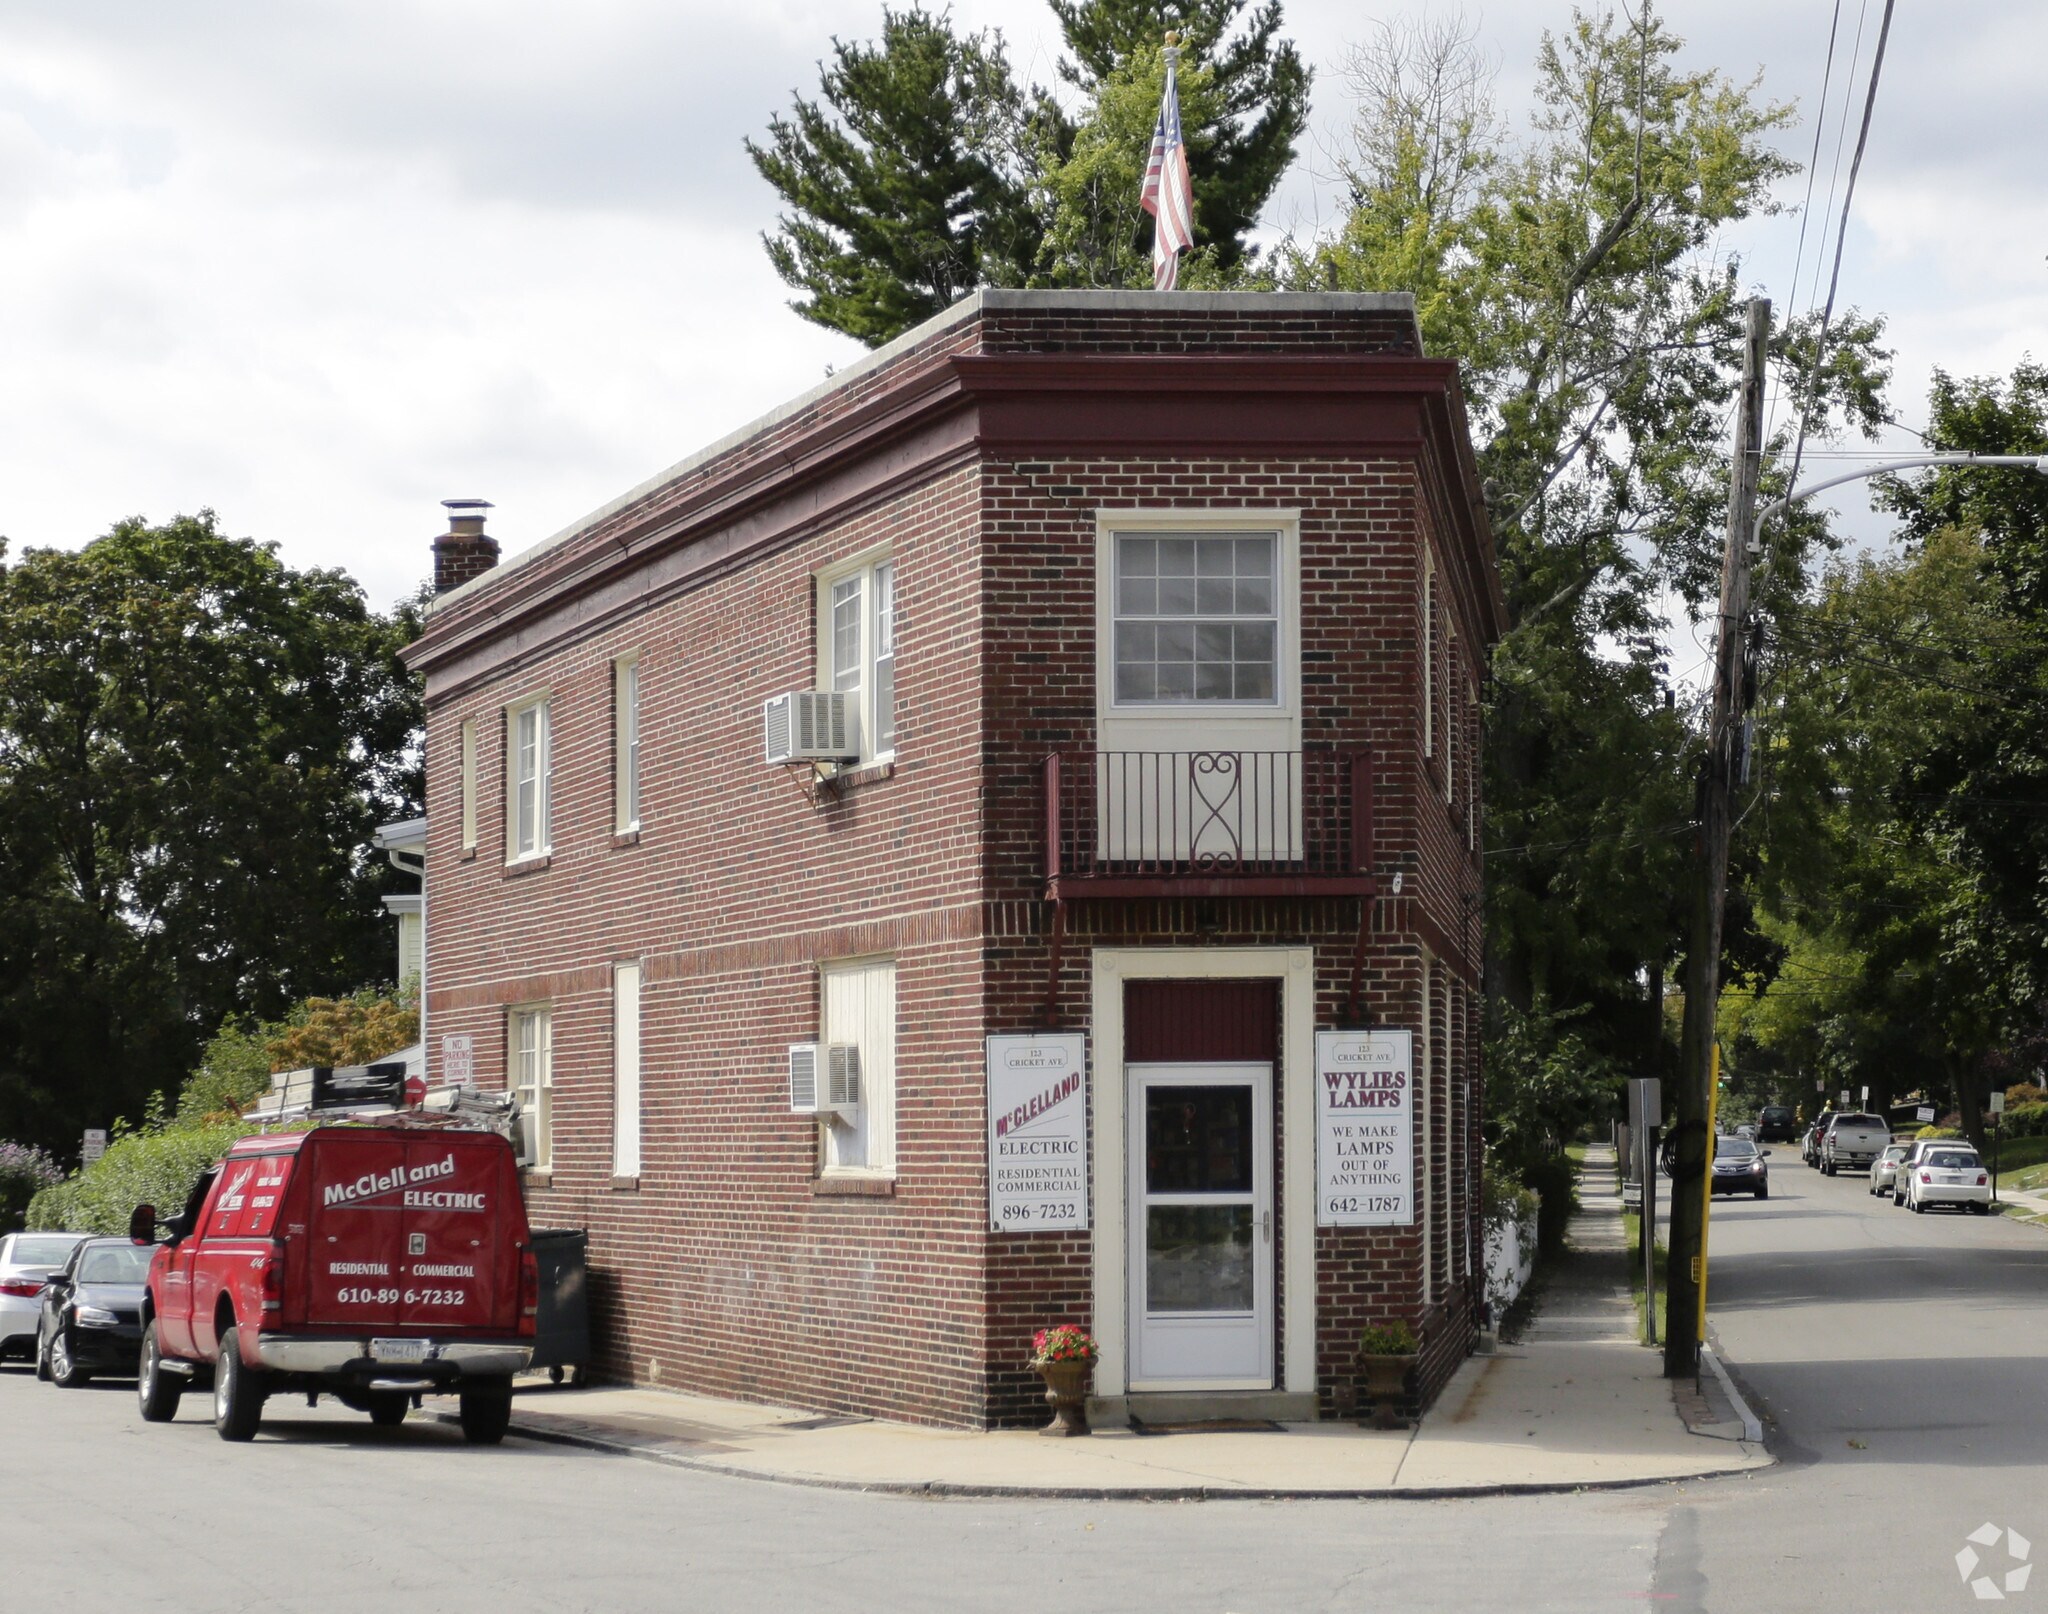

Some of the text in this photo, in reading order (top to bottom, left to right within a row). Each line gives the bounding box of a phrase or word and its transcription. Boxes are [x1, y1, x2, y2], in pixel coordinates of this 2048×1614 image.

[452, 1040, 462, 1049] NO
[1358, 1045, 1370, 1053] 123
[445, 1050, 470, 1060] PARKING
[1030, 1049, 1042, 1057] 123
[1337, 1053, 1391, 1062] CRICKET AVE
[1009, 1057, 1063, 1067] CRICKET AVE
[1323, 1071, 1406, 1090] WYLIES
[1329, 1090, 1401, 1109] LAMPS
[1332, 1125, 1399, 1138] WE MAKE
[998, 1140, 1079, 1156] ELECTRIC
[1336, 1141, 1395, 1156] LAMPS
[1341, 1159, 1390, 1171] OUT OF
[998, 1167, 1081, 1179] RESIDENTIAL
[1330, 1173, 1401, 1185] ANYTHING
[997, 1180, 1082, 1193] COMMERCIAL
[403, 1191, 486, 1209] ELECTRIC
[1330, 1197, 1401, 1212] 642-1787
[1002, 1204, 1077, 1220] 896-7232
[329, 1262, 475, 1278] RESIDENTIAL COMMERCIAL
